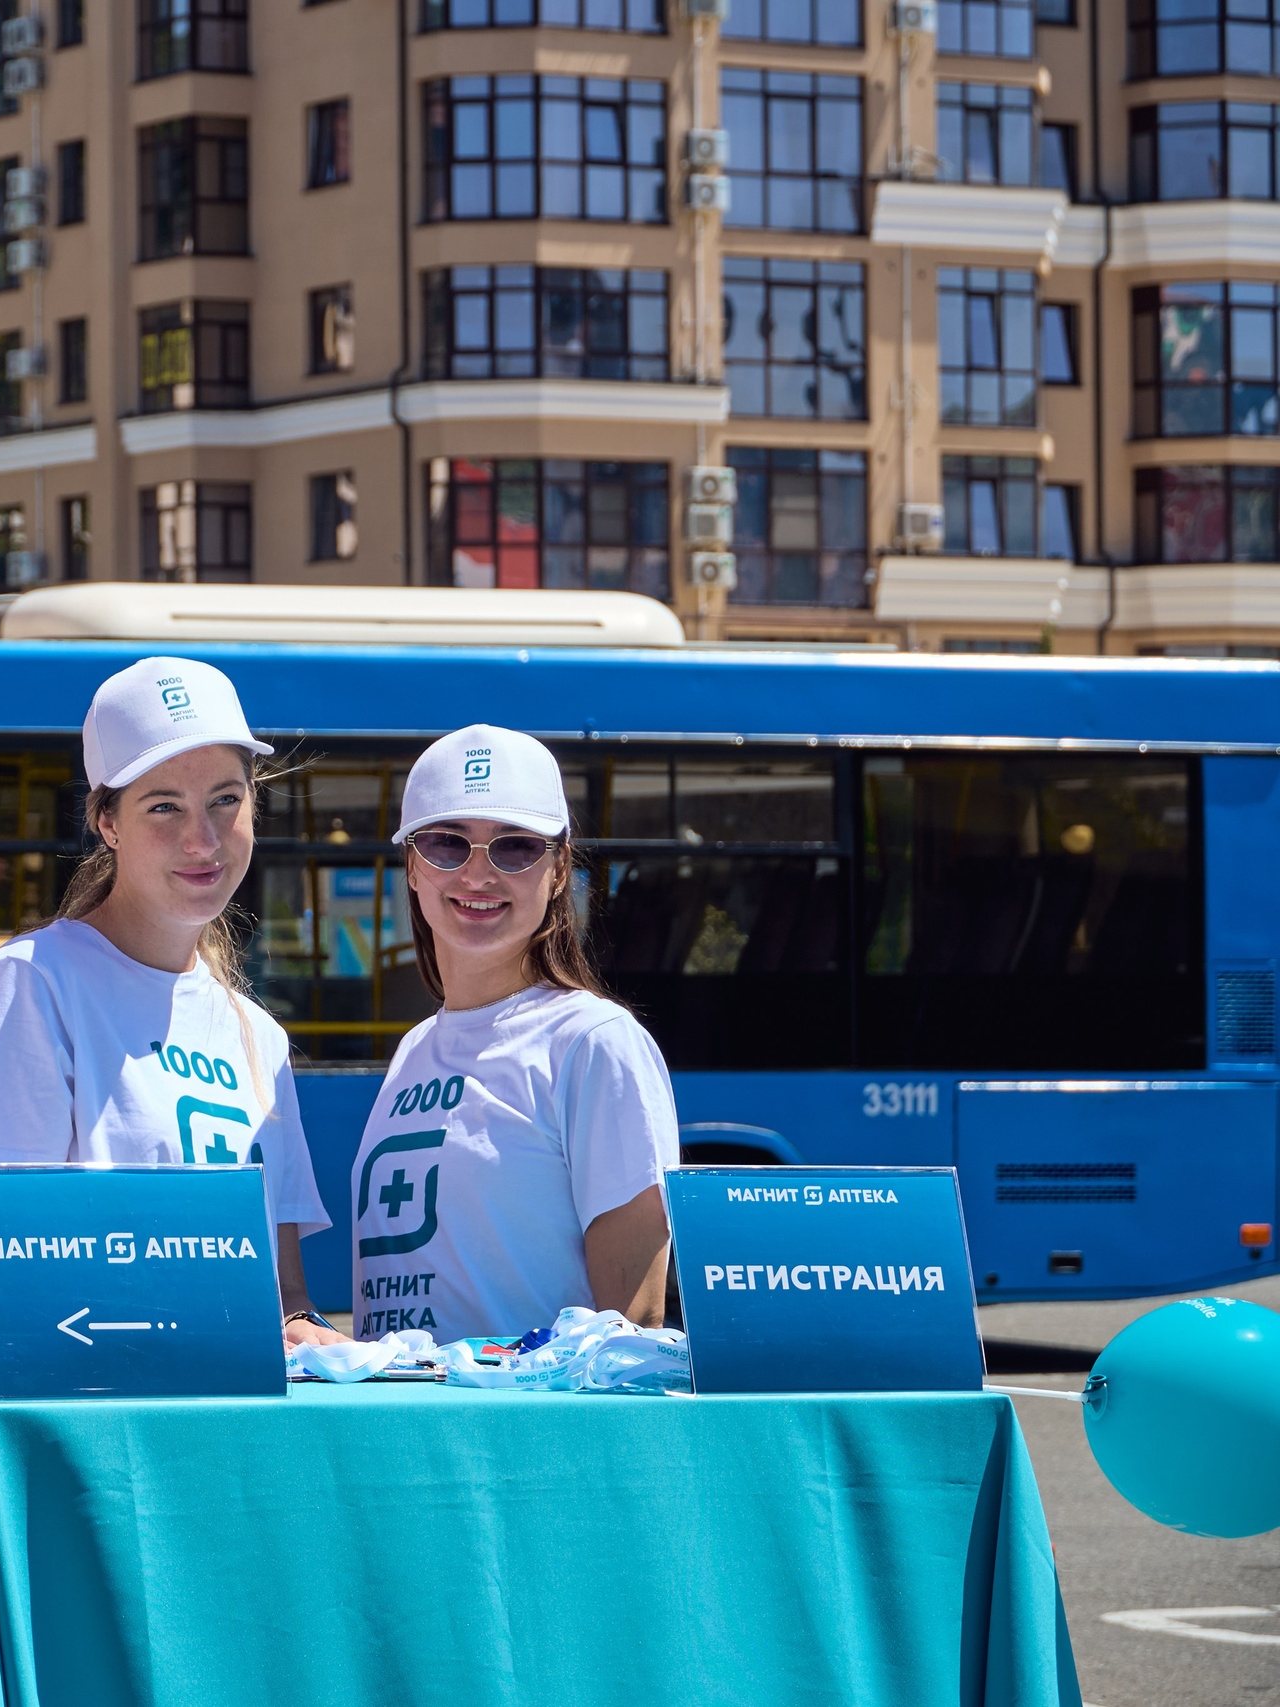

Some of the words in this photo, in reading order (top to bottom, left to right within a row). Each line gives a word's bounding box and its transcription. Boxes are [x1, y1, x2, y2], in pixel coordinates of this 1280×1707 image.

[156, 677, 183, 687] 1000
[170, 709, 195, 717] МАГНИТ
[465, 749, 491, 757] 1000
[150, 1040, 238, 1091] 1000
[389, 1075, 465, 1118] 1000
[862, 1082, 939, 1117] 33111
[727, 1188, 798, 1202] МАГНИТ
[828, 1189, 899, 1203] АПТЕКА
[145, 1237, 258, 1259] АПТЕКА
[704, 1265, 945, 1295] РЕГИСТРАЦИЯ
[360, 1307, 437, 1337] АПТЕКА
[657, 1344, 678, 1357] 1000
[515, 1375, 537, 1383] 1000
